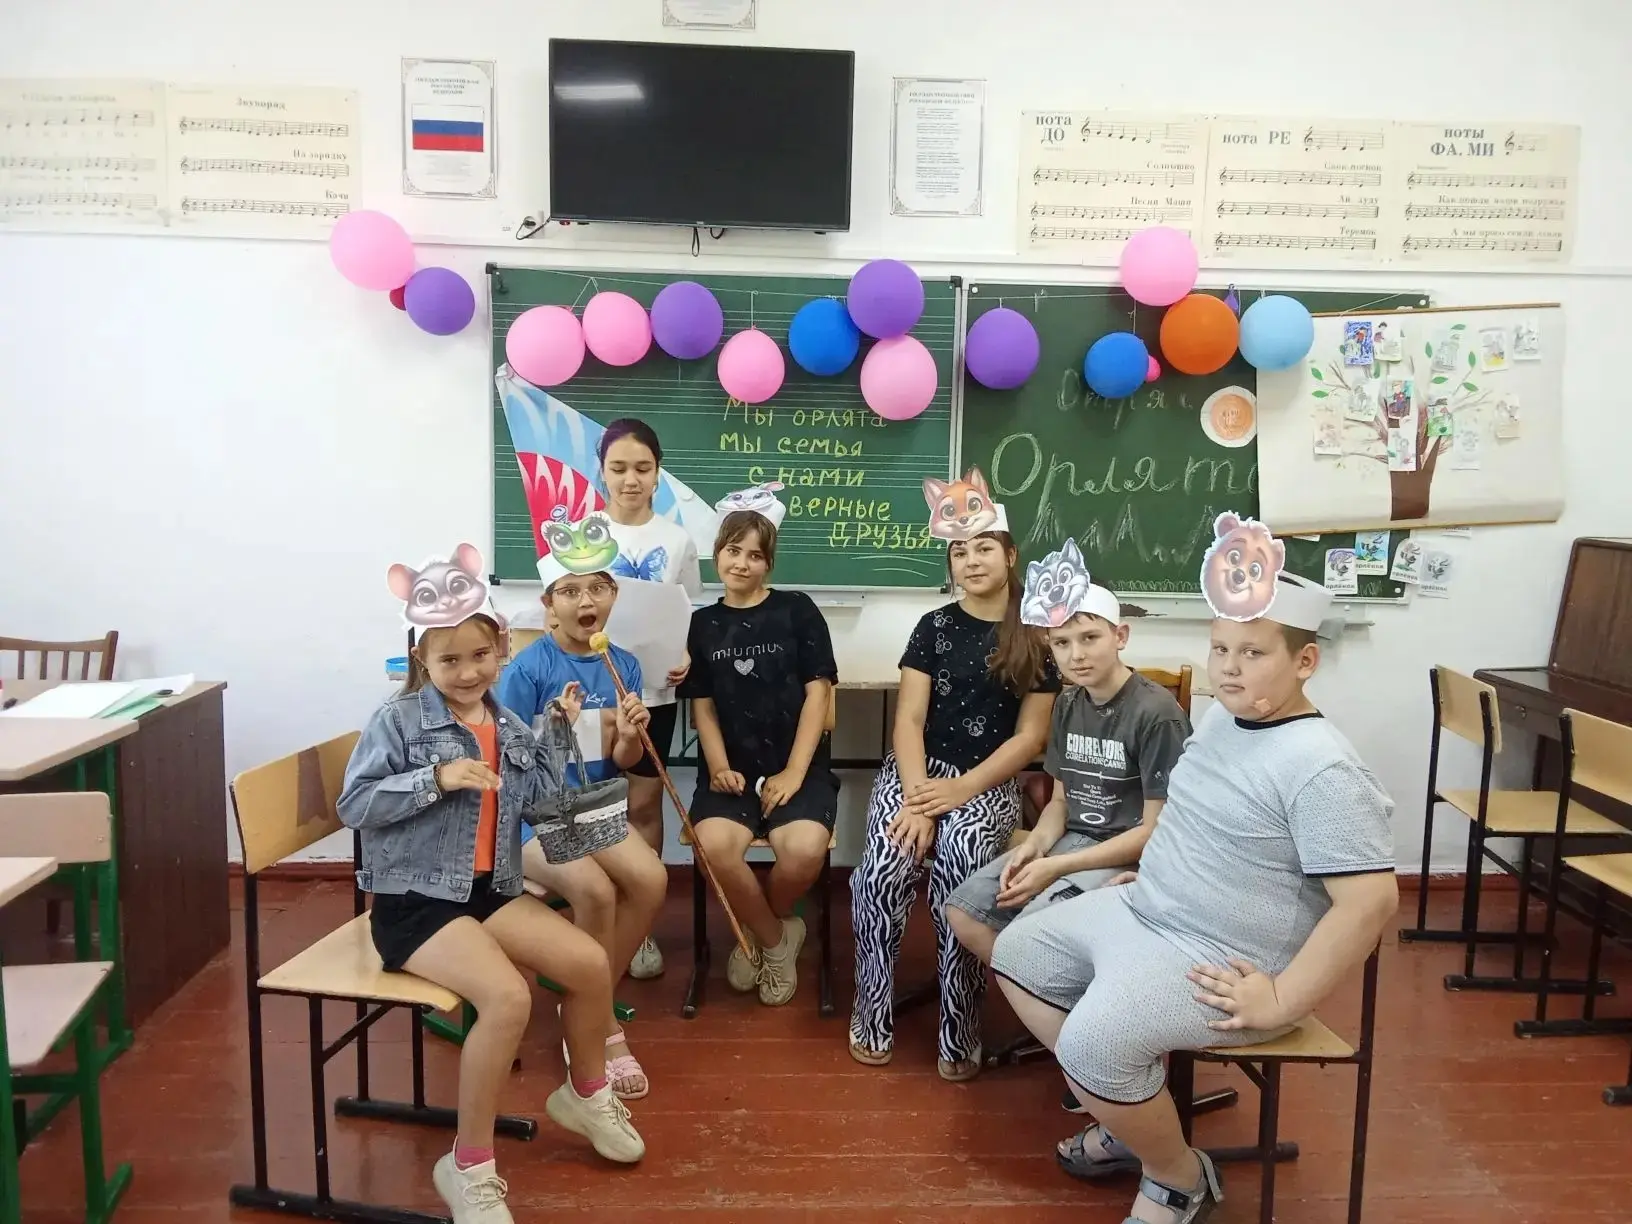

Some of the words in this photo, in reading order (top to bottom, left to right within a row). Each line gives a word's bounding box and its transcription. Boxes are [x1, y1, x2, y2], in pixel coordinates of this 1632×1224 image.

[1035, 115, 1072, 126] нота
[1040, 127, 1065, 144] ДО
[1222, 133, 1258, 145] нота
[1268, 130, 1291, 145] РЕ
[1444, 128, 1485, 139] ноты
[1466, 142, 1494, 156] МИ
[777, 435, 863, 457] семья
[778, 466, 865, 487] нами
[789, 495, 892, 522] верные
